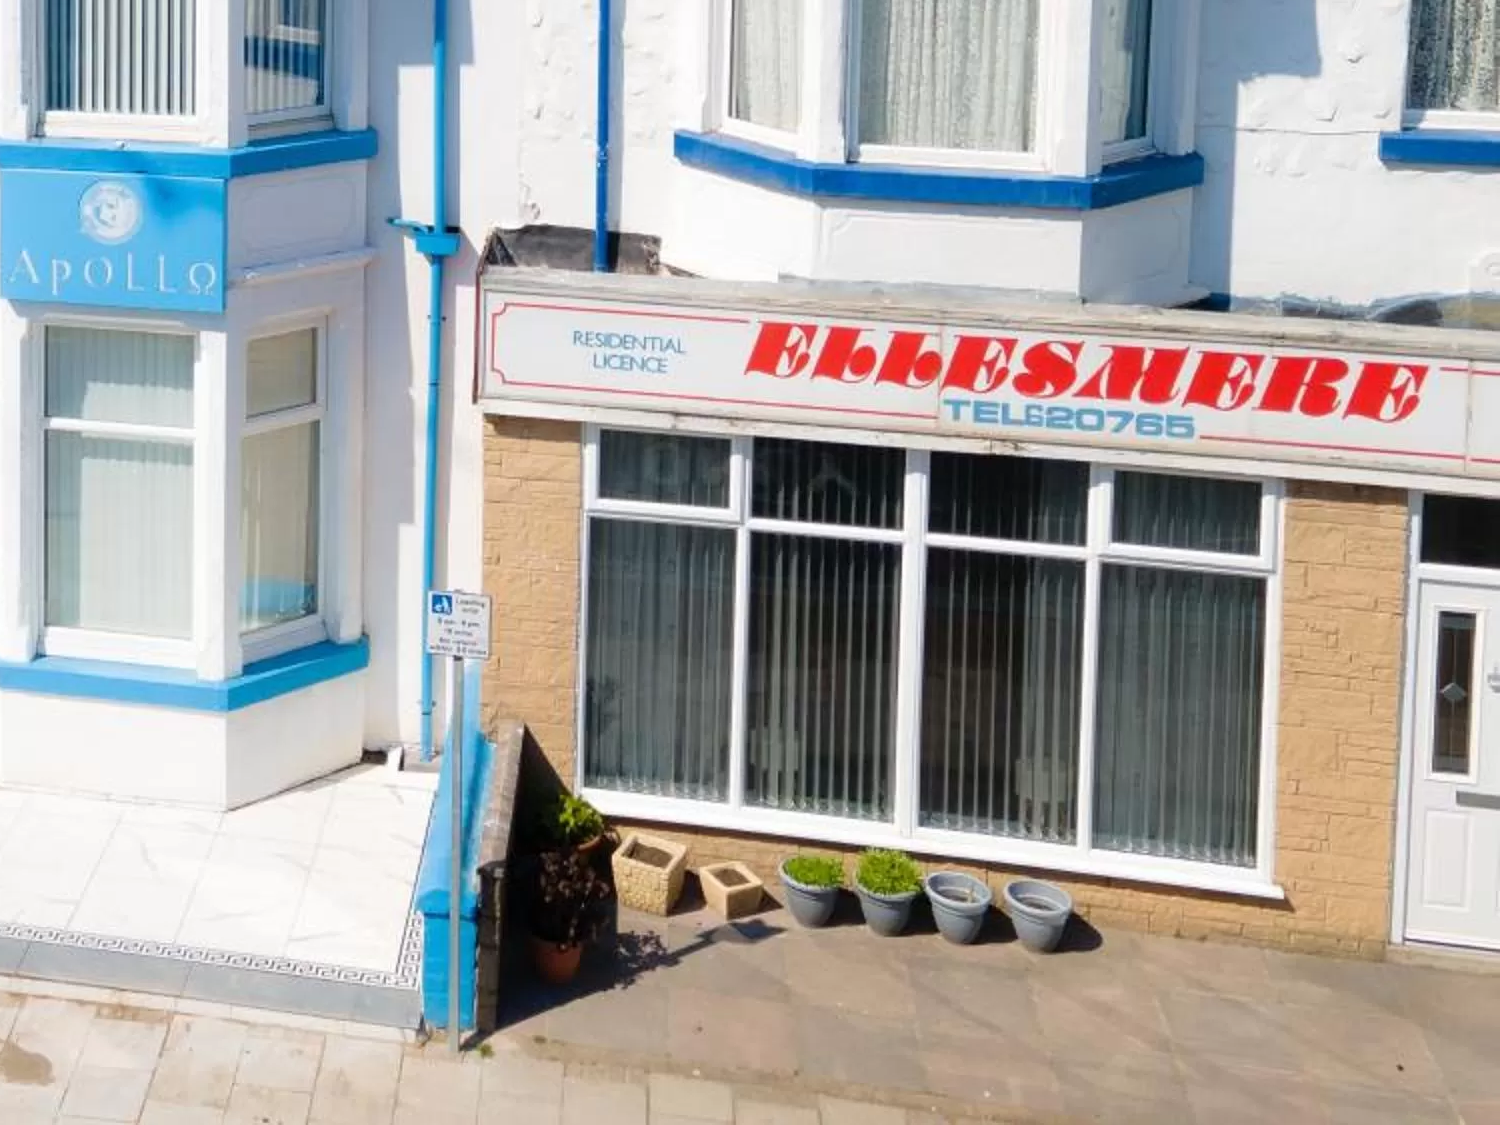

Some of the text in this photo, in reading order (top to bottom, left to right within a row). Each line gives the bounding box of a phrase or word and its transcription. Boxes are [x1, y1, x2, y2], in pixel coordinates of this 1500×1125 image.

[573, 330, 687, 355] RESIDENTIAL
[593, 353, 668, 374] LICENCE
[745, 321, 1428, 422] ELLESMERE
